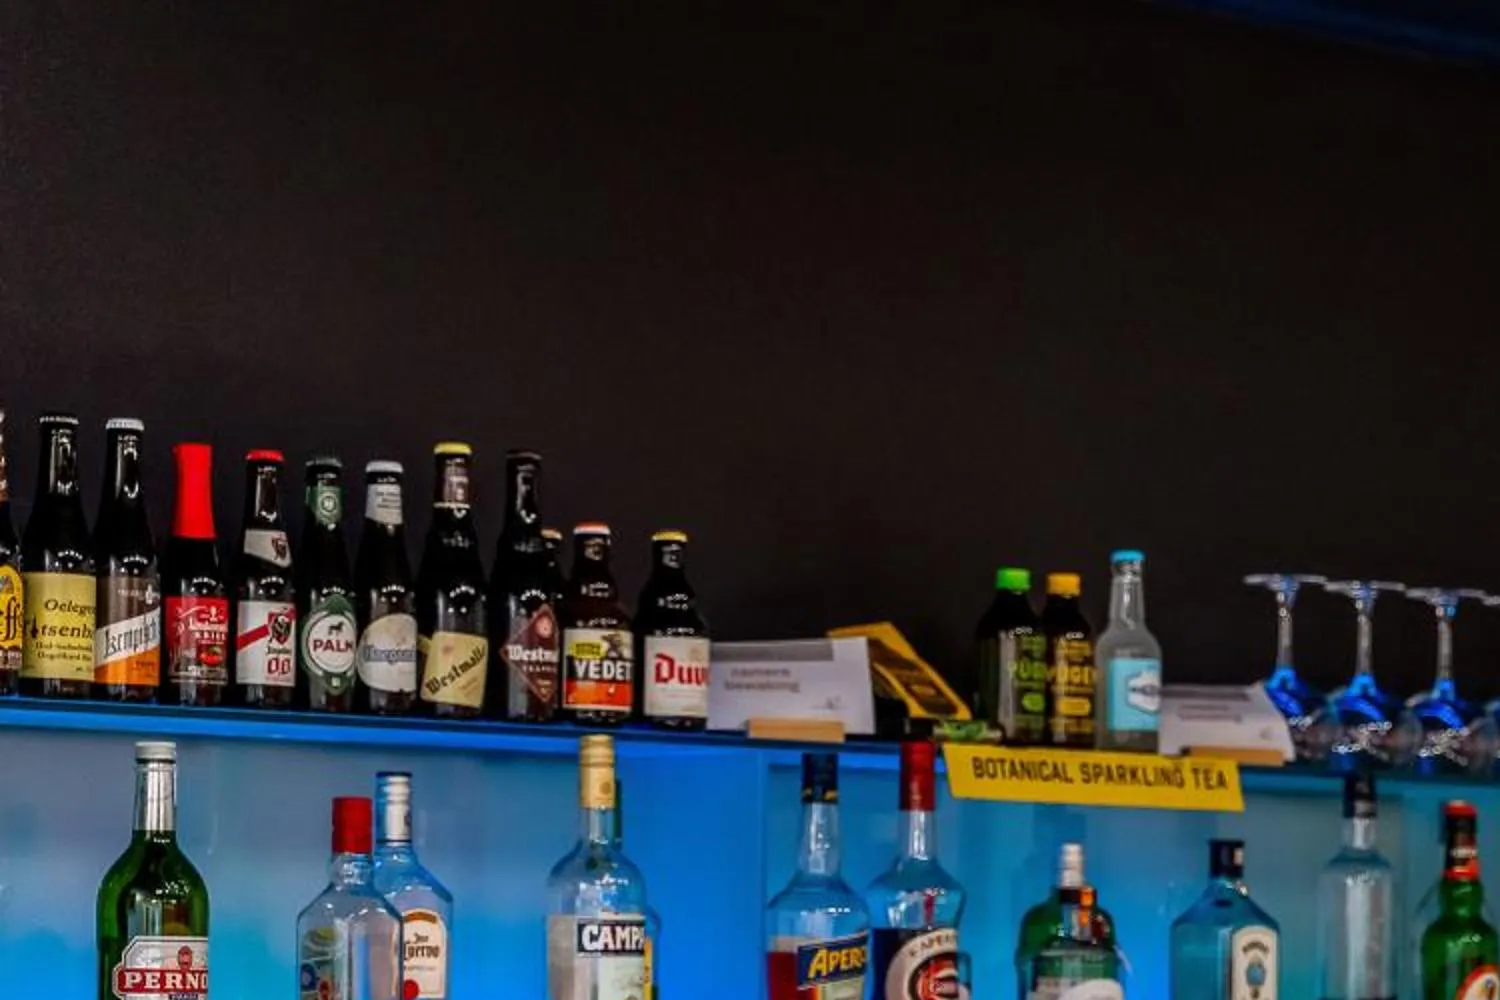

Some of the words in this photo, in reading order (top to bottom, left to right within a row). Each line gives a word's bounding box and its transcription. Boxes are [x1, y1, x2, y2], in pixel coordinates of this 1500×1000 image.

[971, 757, 1074, 784] BOTANICAL
[1080, 762, 1185, 789] SPARKLING
[1191, 767, 1228, 790] TEA
